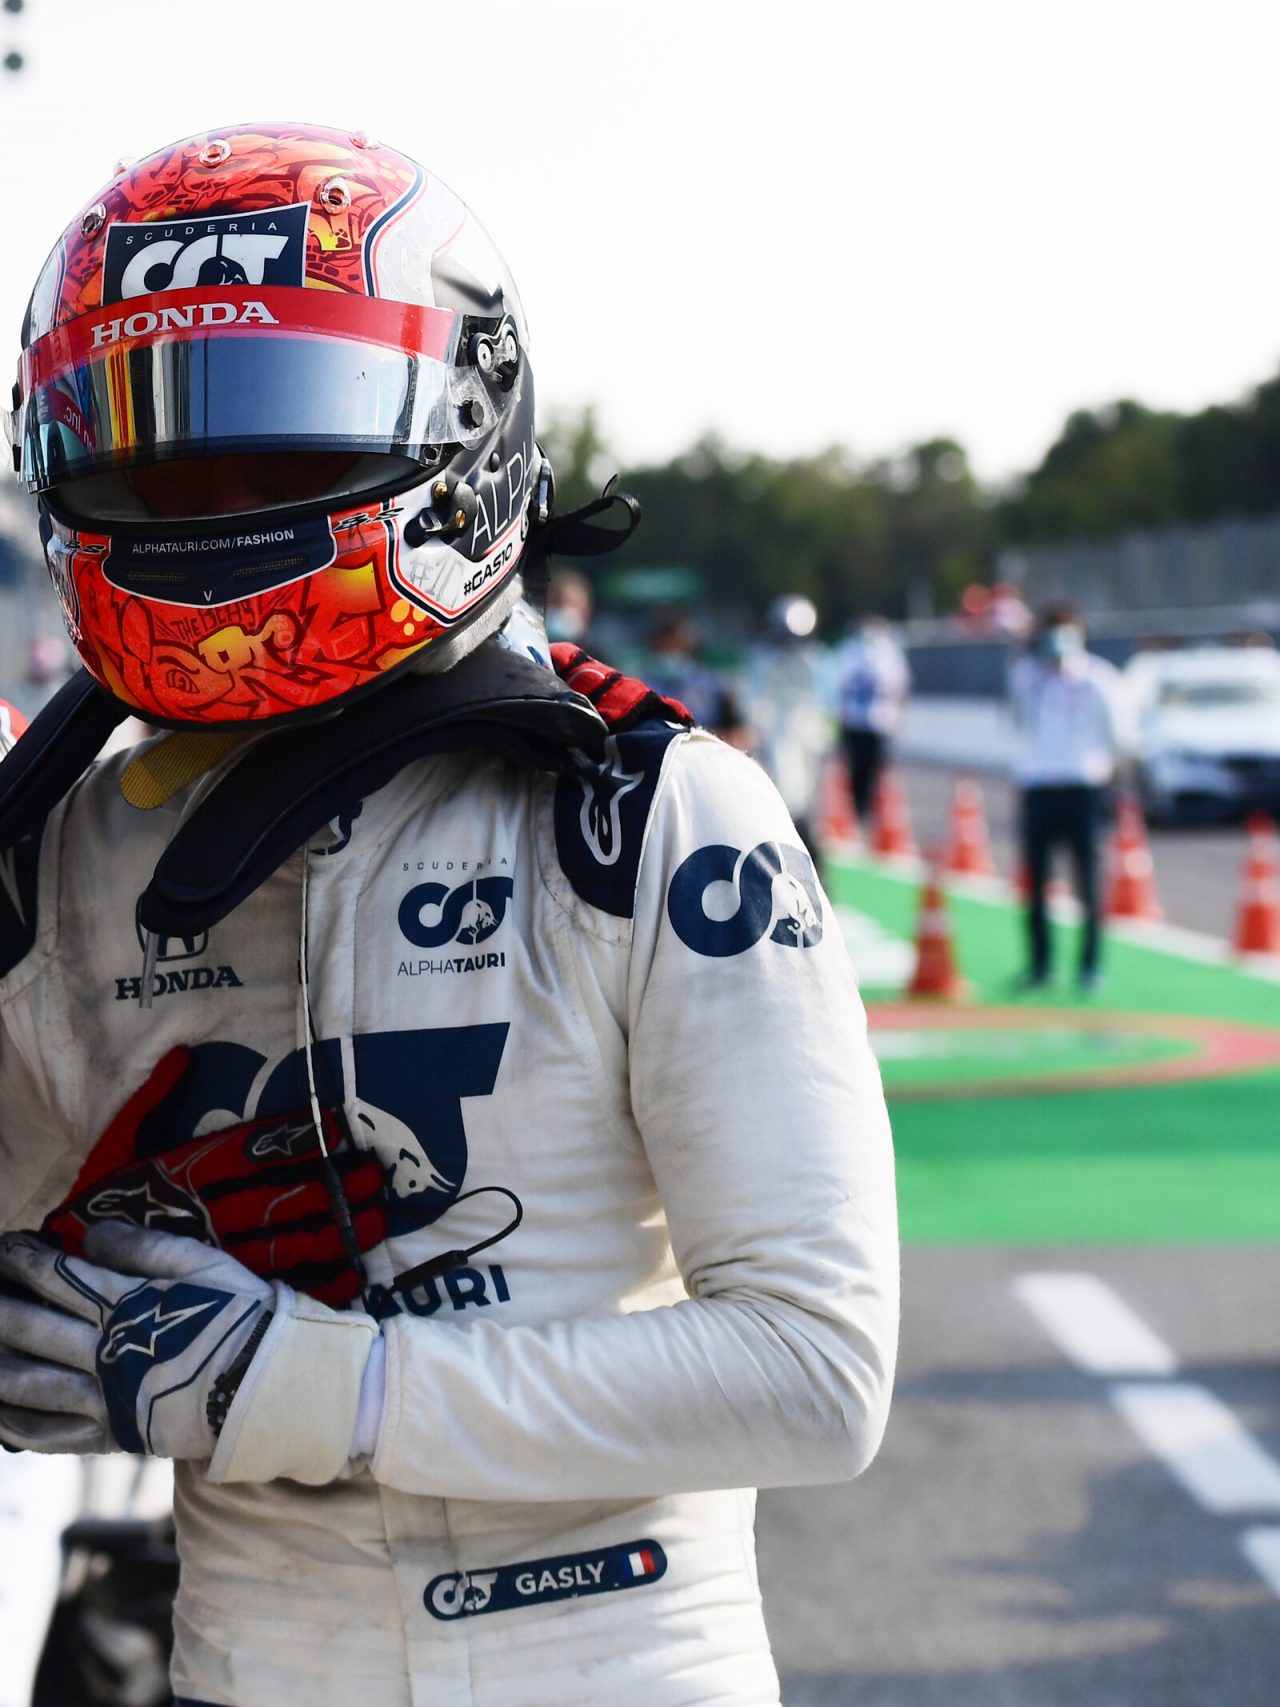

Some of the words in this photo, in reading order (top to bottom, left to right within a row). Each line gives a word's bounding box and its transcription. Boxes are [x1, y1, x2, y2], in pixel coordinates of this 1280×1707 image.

[125, 222, 278, 245] SCUDERIA
[90, 301, 280, 349] HONDA
[131, 529, 295, 554] ALPHATAURI.COM/FASHION
[463, 542, 513, 596] #GAS10
[397, 952, 506, 977] ALPHATAURI
[515, 1560, 605, 1596] GASLY
